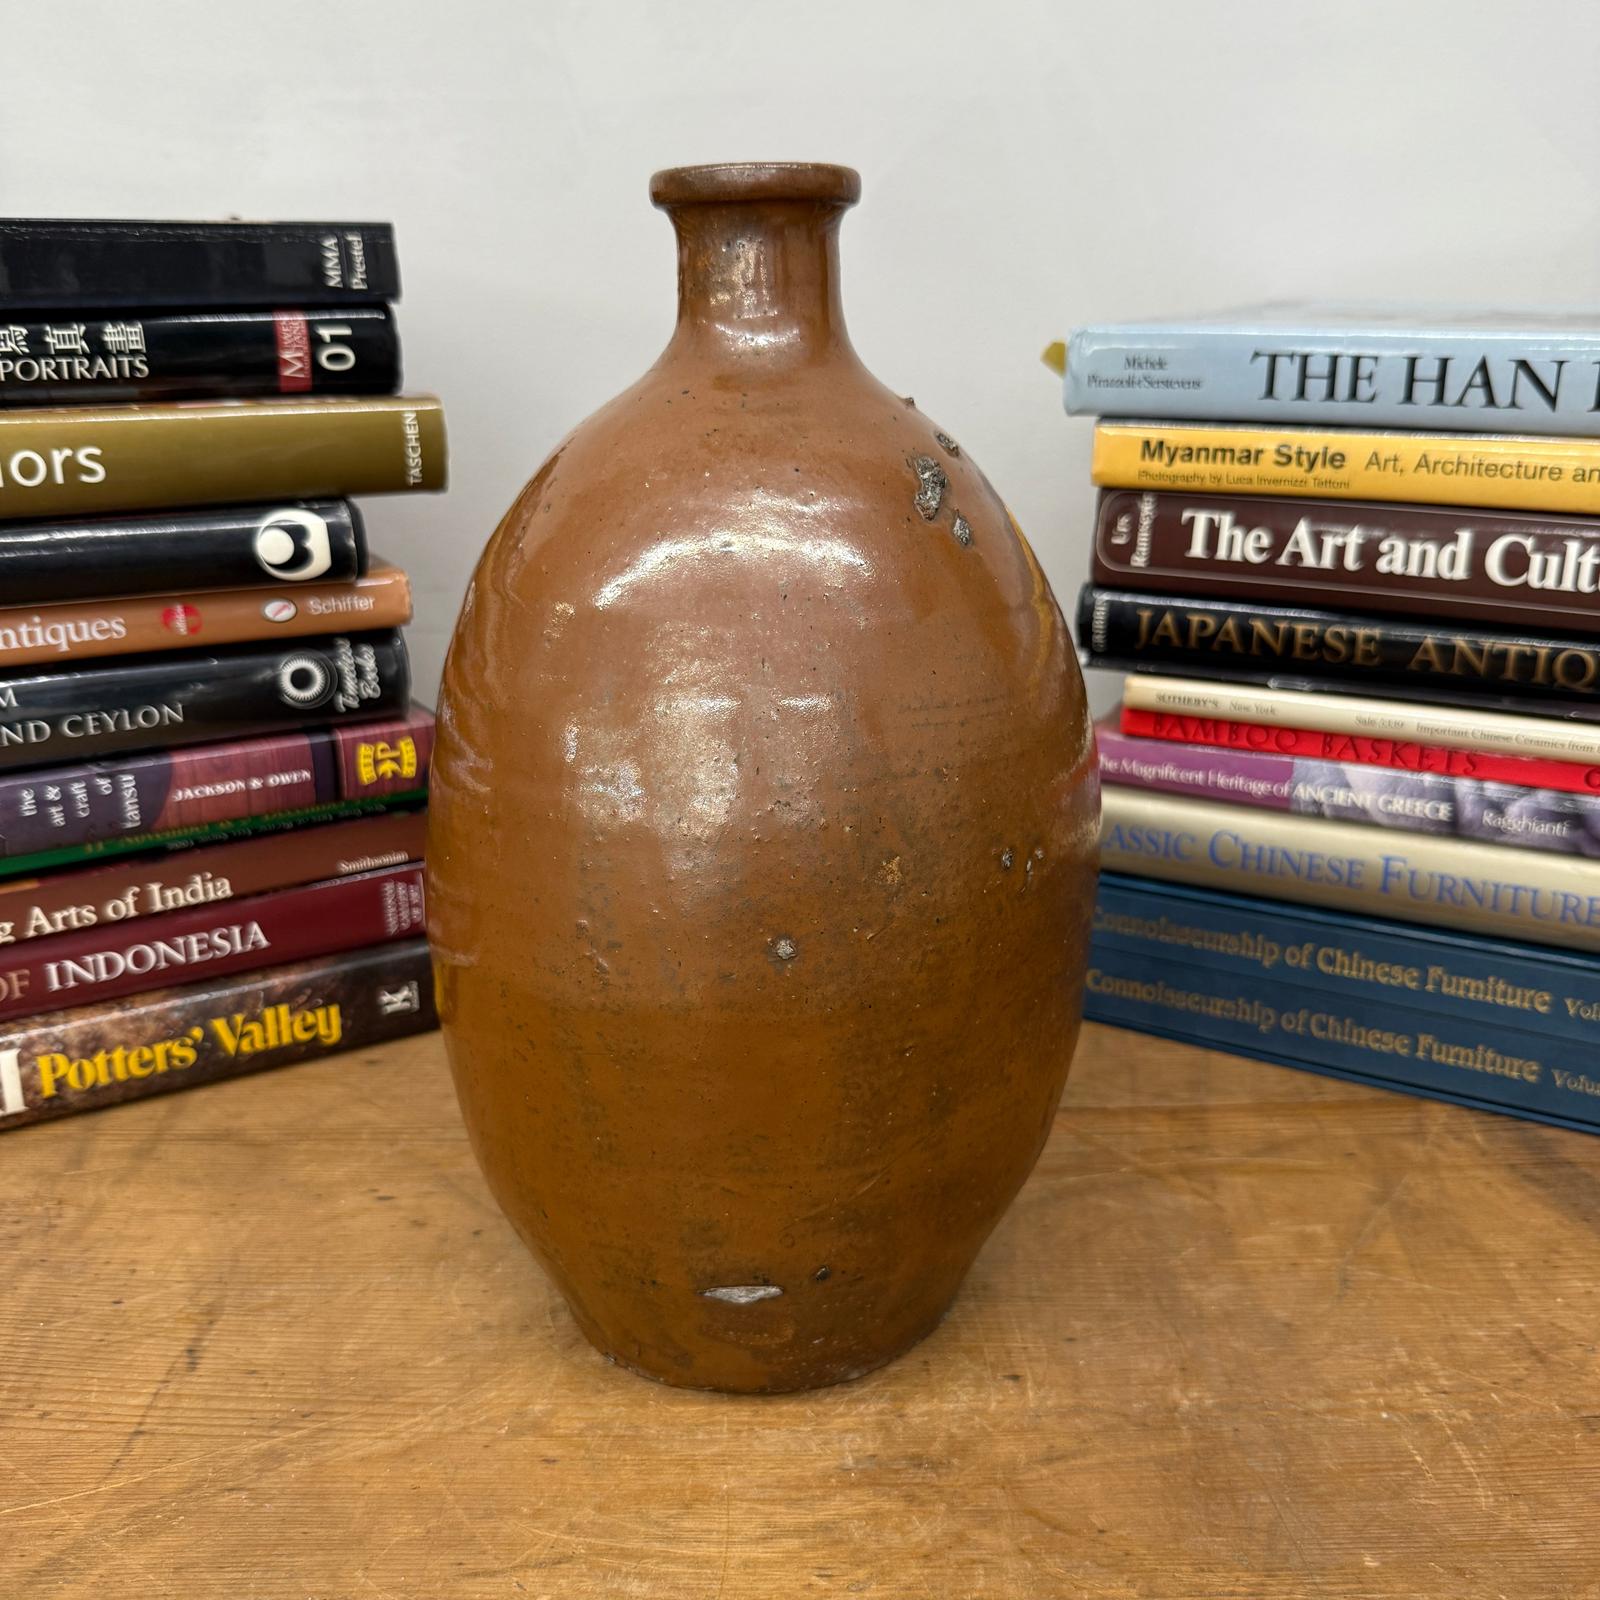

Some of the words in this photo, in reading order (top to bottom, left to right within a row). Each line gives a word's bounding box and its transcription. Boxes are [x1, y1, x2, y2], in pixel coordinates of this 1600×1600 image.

[320, 234, 344, 287] MMA
[0, 355, 149, 381] PORTRAITS
[316, 324, 355, 371] 01
[1250, 350, 1380, 403] THE
[1398, 354, 1569, 413] HAN
[402, 410, 422, 485] TASCHEN
[1140, 439, 1263, 467] Myanmar
[1273, 444, 1347, 473] Style
[1365, 451, 1404, 475] Art,
[1414, 453, 1563, 482] Architecture
[1138, 471, 1205, 484] Photography
[1209, 473, 1222, 485] by
[1181, 508, 1274, 564] The
[1275, 516, 1366, 571] Art
[1376, 528, 1474, 581] and
[1485, 532, 1600, 594] Cult
[307, 596, 375, 615] Schiffer
[1136, 608, 1382, 666] JAPANESE
[1407, 634, 1600, 693] ANTIQ
[59, 703, 184, 737] CEYLON
[1416, 722, 1468, 741] Important
[1471, 727, 1513, 743] Chinese
[1515, 732, 1566, 749] Ceramics
[1568, 739, 1595, 753] from
[19, 788, 38, 816] the
[44, 785, 62, 801] &
[94, 777, 113, 795] of
[117, 774, 142, 829] tansu
[173, 781, 245, 802] JACKSON
[250, 776, 264, 790] &
[267, 769, 312, 788] OWEN
[1120, 759, 1204, 785] Magnificent
[1207, 770, 1272, 797] Heritage
[1273, 779, 1291, 797] of
[1292, 782, 1377, 810] ANCIENT
[1377, 793, 1453, 821] GREECE
[337, 851, 409, 874] Smithsonian
[1208, 829, 1365, 890] CHINESE
[25, 905, 99, 939] Arts
[105, 886, 141, 921] of
[147, 871, 234, 915] India
[45, 920, 272, 992] INDONESIA
[1285, 943, 1315, 970] of
[1316, 947, 1421, 990] Chinese
[1425, 965, 1553, 1014] Furniture
[210, 1003, 343, 1057] Valley
[1279, 1008, 1310, 1035] of
[1310, 1013, 1412, 1057] Chinese
[1416, 1032, 1541, 1084] Furniture
[1551, 1069, 1600, 1096] Volu
